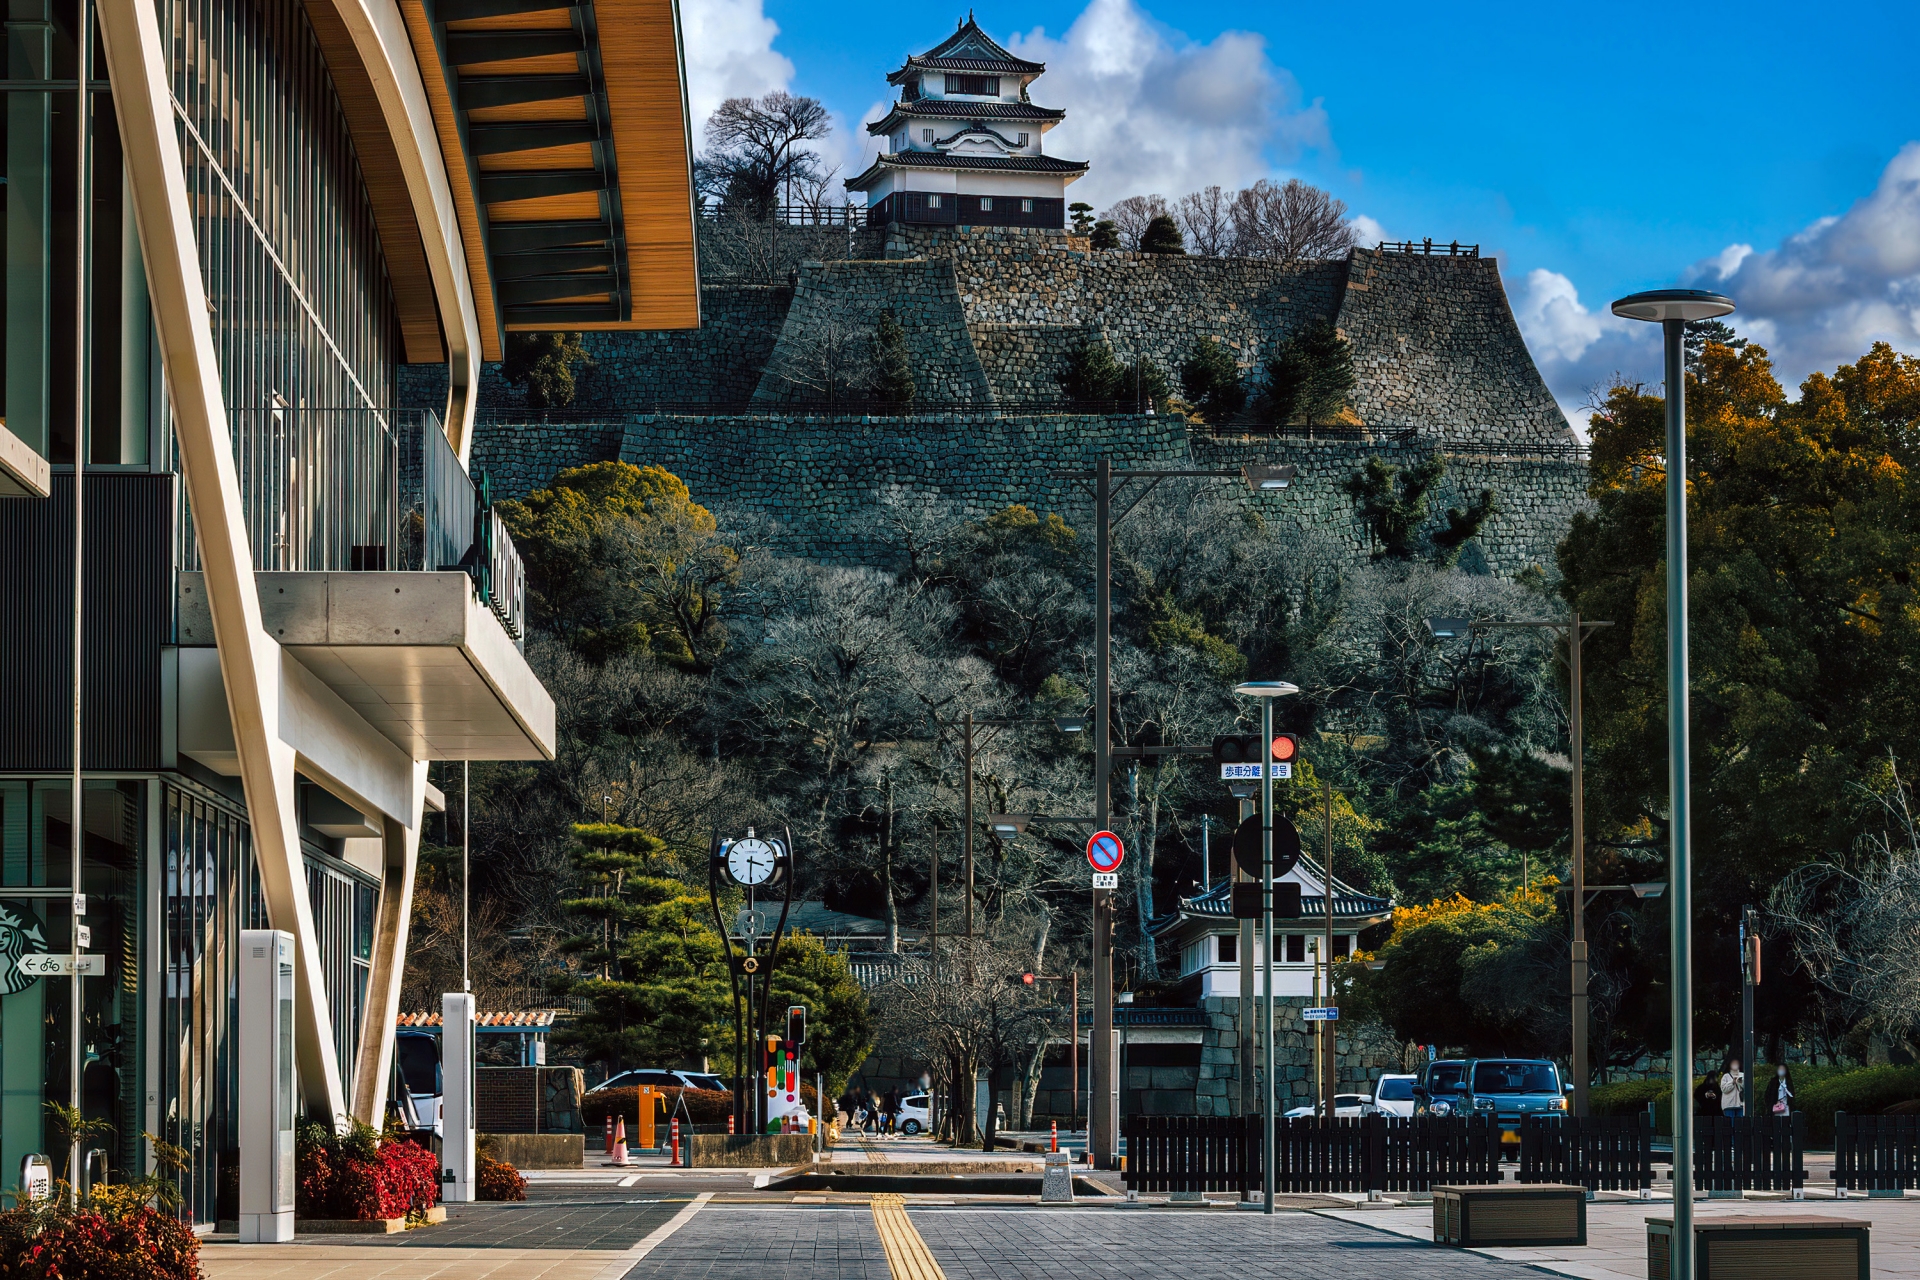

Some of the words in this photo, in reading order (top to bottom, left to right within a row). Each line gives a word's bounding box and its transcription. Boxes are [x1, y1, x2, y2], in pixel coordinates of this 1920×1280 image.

[1225, 765, 1288, 777] 歩車分離信号
